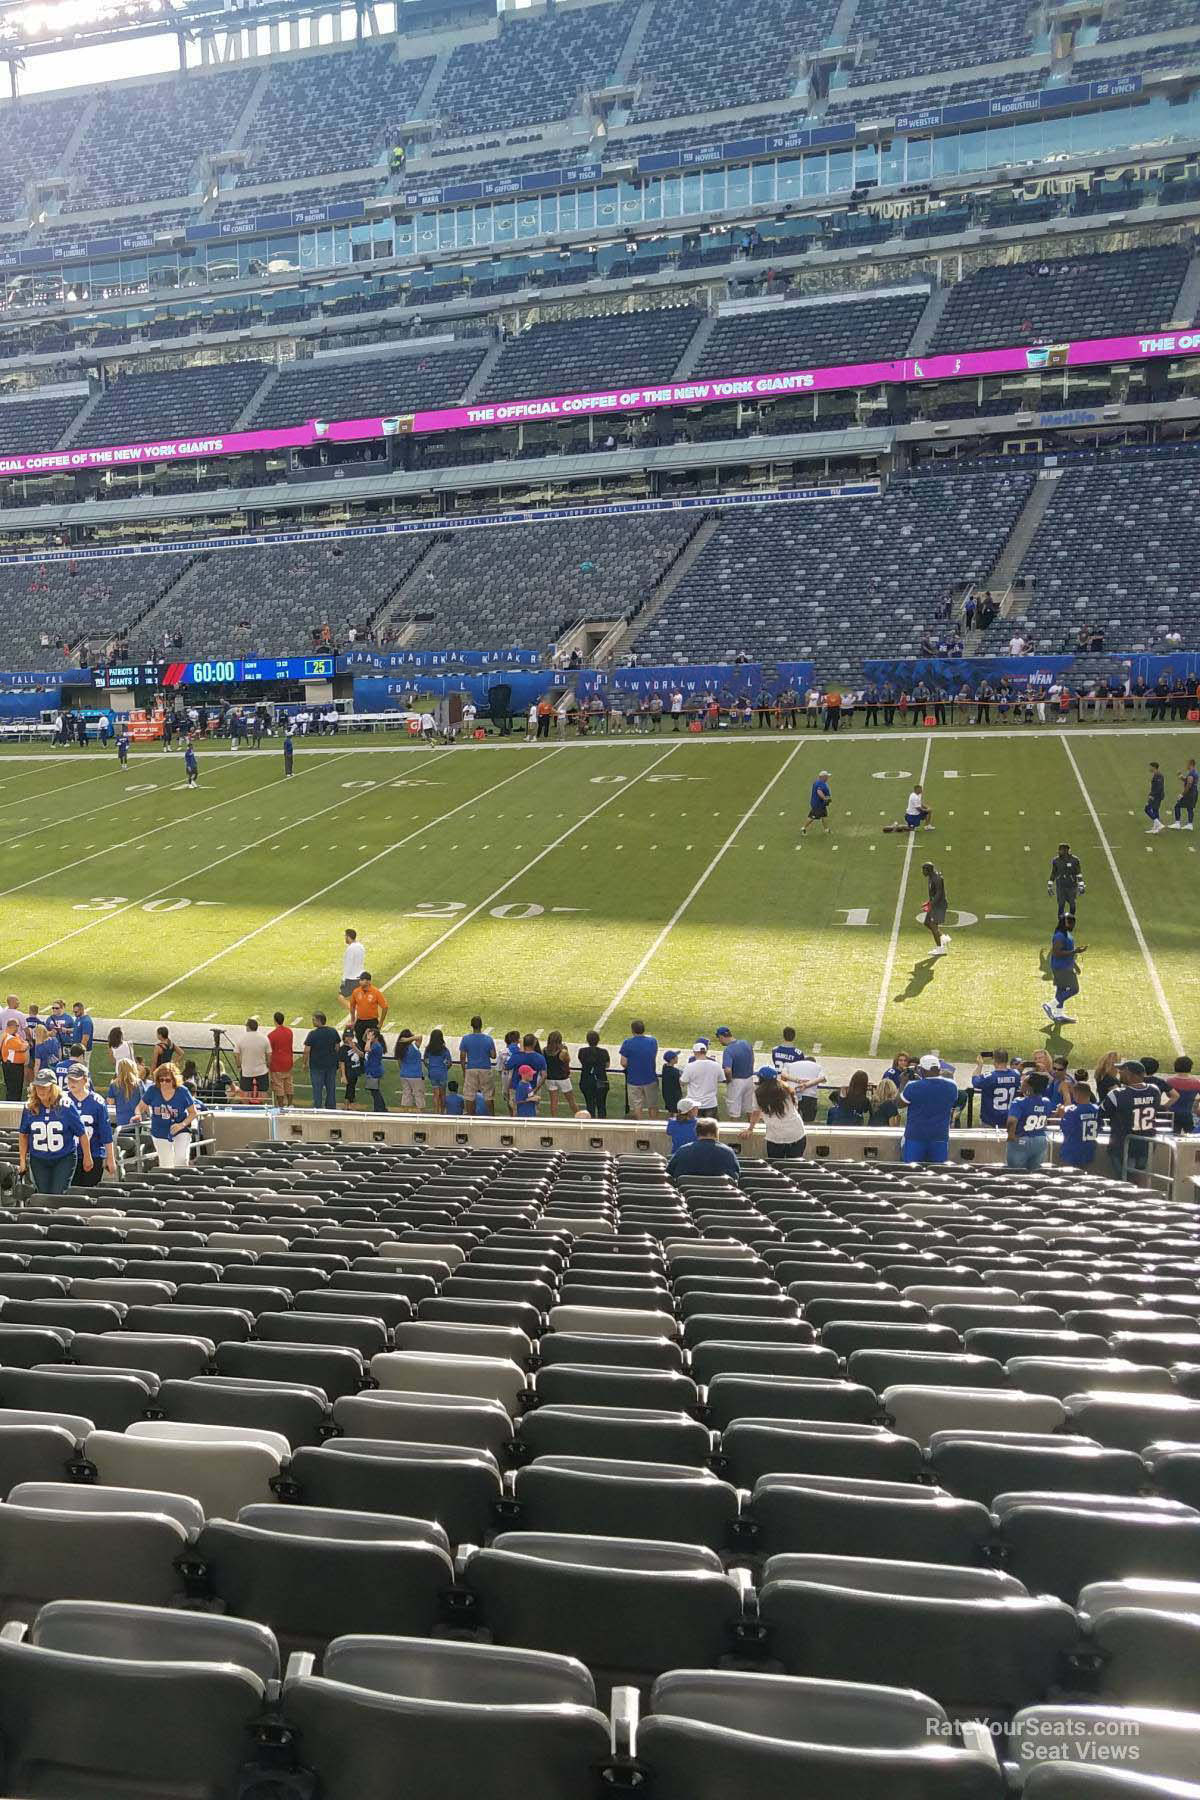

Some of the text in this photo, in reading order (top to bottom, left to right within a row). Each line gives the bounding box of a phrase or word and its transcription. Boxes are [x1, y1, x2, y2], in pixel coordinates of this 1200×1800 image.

[1097, 83, 1135, 96] 22 LYNCH
[1001, 100, 1038, 113] ROBUSTELLI
[909, 116, 940, 128] WEBSTER
[773, 138, 802, 148] 70 HUFF
[694, 151, 720, 162] HOWELL
[579, 170, 596, 180] TISCH
[494, 183, 519, 193] GIFFORD
[304, 213, 325, 222] BROWN
[1139, 337, 1175, 352] THE
[467, 374, 814, 421] THE OFFICIAL COFFEE OF THE NEW YORK GIANTS
[1040, 412, 1096, 426] MetLife
[26, 456, 70, 468] COFFEE
[71, 454, 88, 464] OF
[89, 452, 112, 463] THE
[114, 449, 142, 461] NEW
[143, 445, 176, 458] YORK
[178, 440, 223, 453] GIANTS
[109, 668, 132, 676] PATRIOTS
[193, 662, 234, 682] 60:00
[313, 661, 325, 673] 25
[109, 678, 132, 686] GIANTS
[1029, 670, 1053, 684] WFAN
[72, 896, 192, 912] 30
[403, 901, 529, 919] 20
[832, 908, 978, 928] 10
[993, 1087, 1016, 1111] 21
[1132, 1107, 1155, 1131] 12
[31, 1121, 64, 1152] 26
[1082, 1120, 1098, 1141] 13
